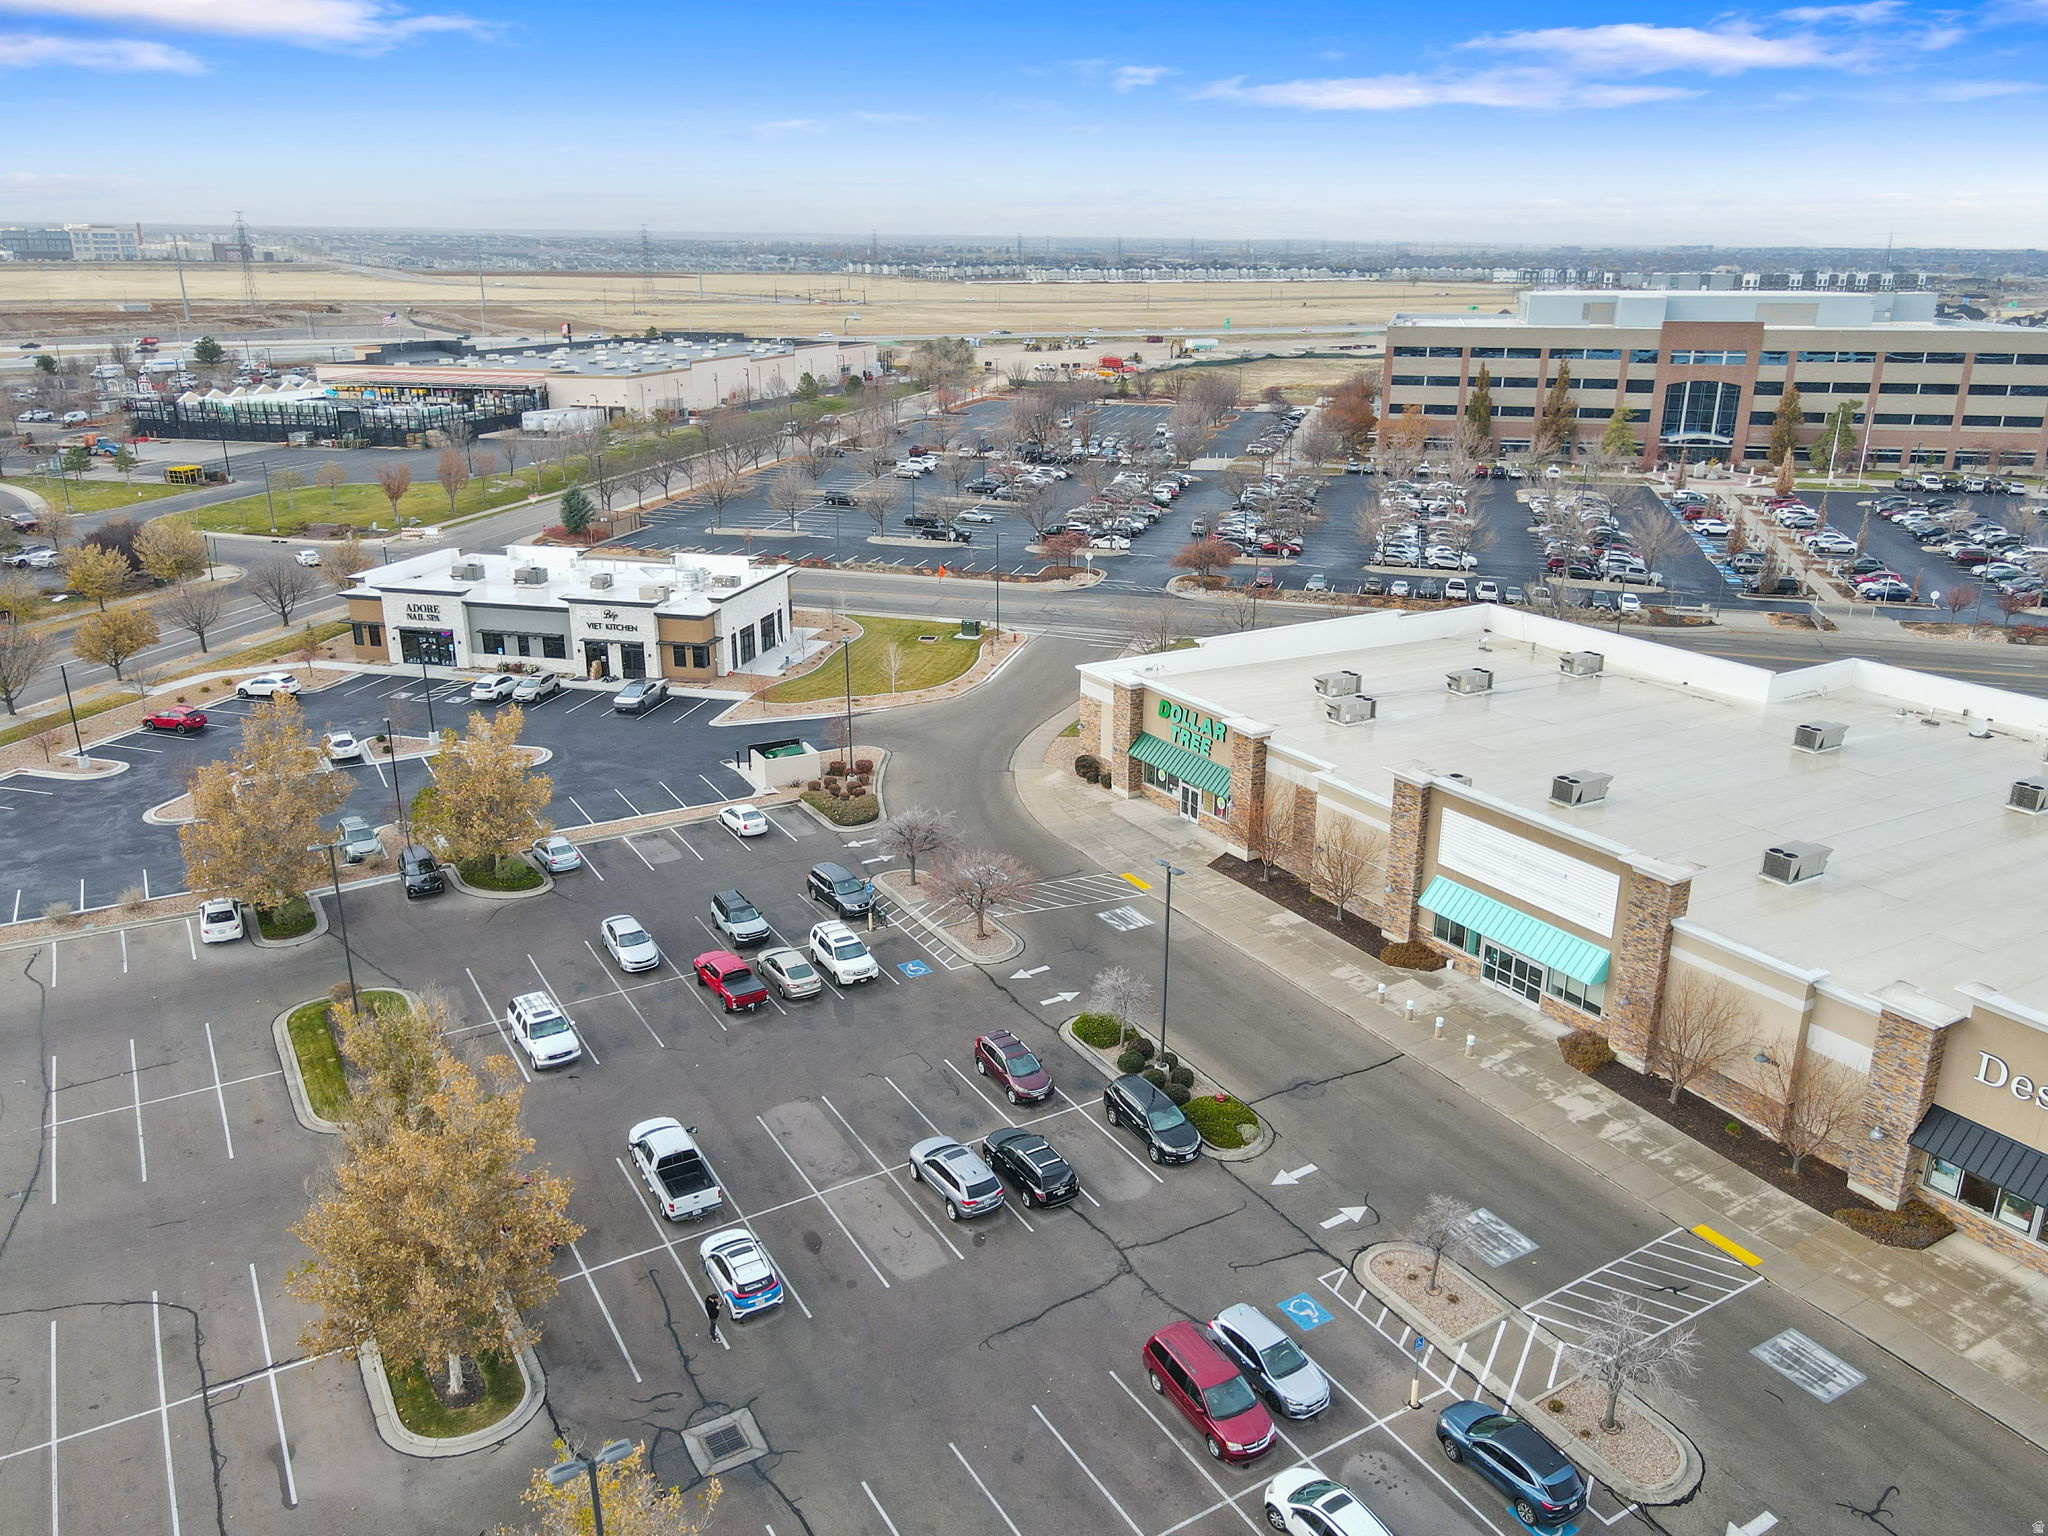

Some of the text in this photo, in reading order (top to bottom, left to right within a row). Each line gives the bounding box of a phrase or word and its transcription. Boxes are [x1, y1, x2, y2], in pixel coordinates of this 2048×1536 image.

[406, 603, 441, 614] ADORE
[406, 613, 441, 622] NAIL SPA
[586, 622, 638, 632] VIET KITCHEN
[1158, 699, 1227, 743] DOLLAR
[1169, 723, 1213, 757] TREE
